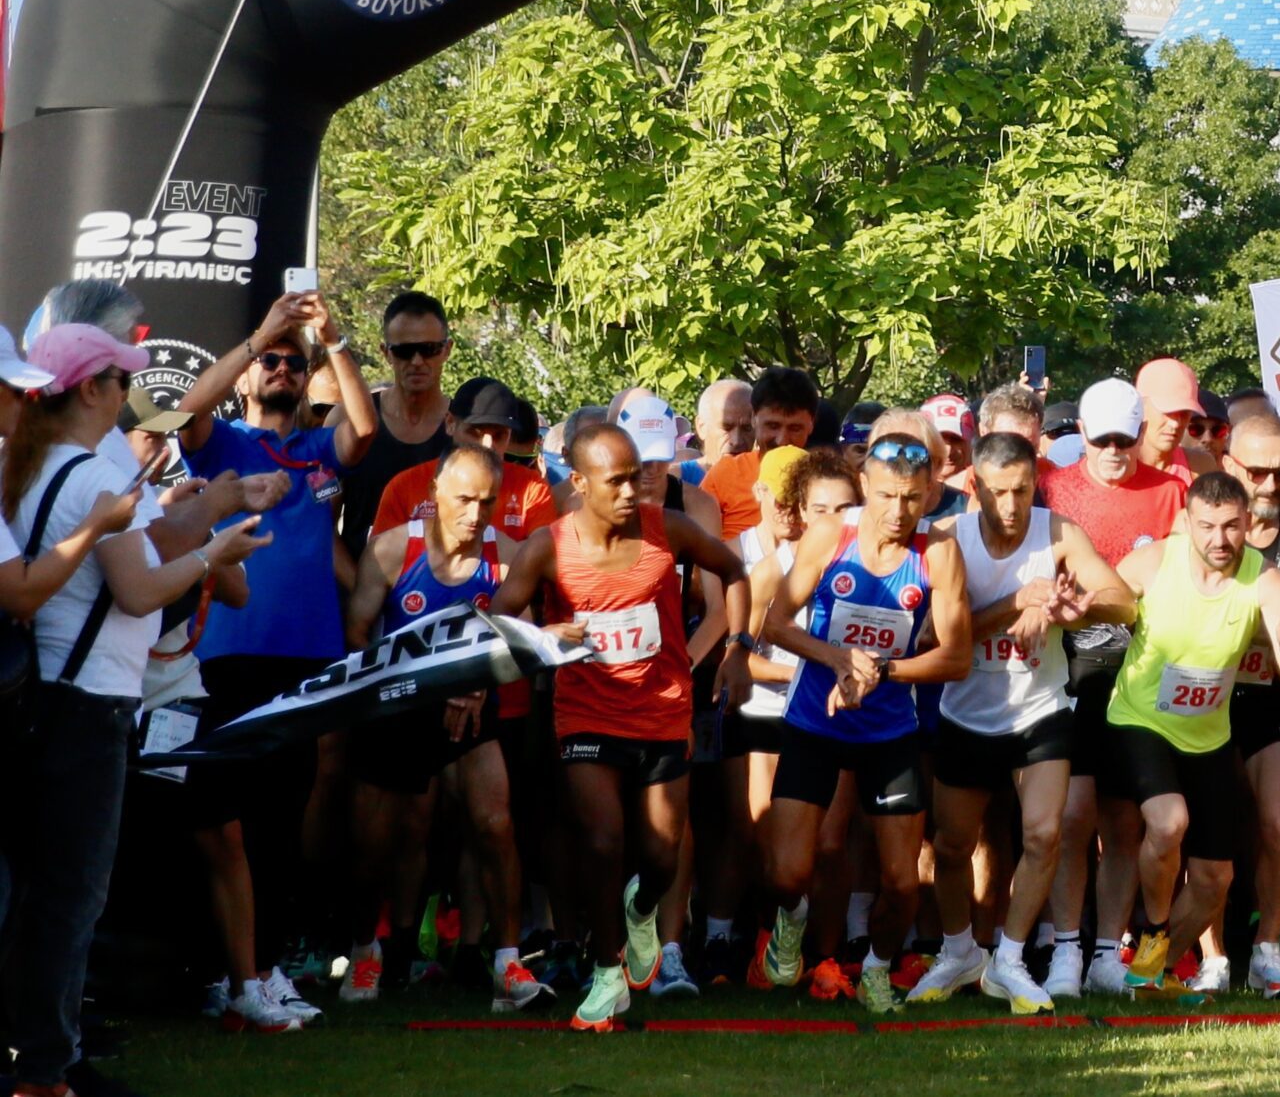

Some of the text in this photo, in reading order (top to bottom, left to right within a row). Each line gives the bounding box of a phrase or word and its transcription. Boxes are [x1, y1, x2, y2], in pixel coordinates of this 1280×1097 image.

[162, 179, 268, 217] EVENT
[75, 210, 259, 261] 2:23
[145, 372, 195, 390] GENÇLİ
[591, 626, 644, 653] 317
[843, 623, 896, 650] 259
[1171, 683, 1222, 708] 287
